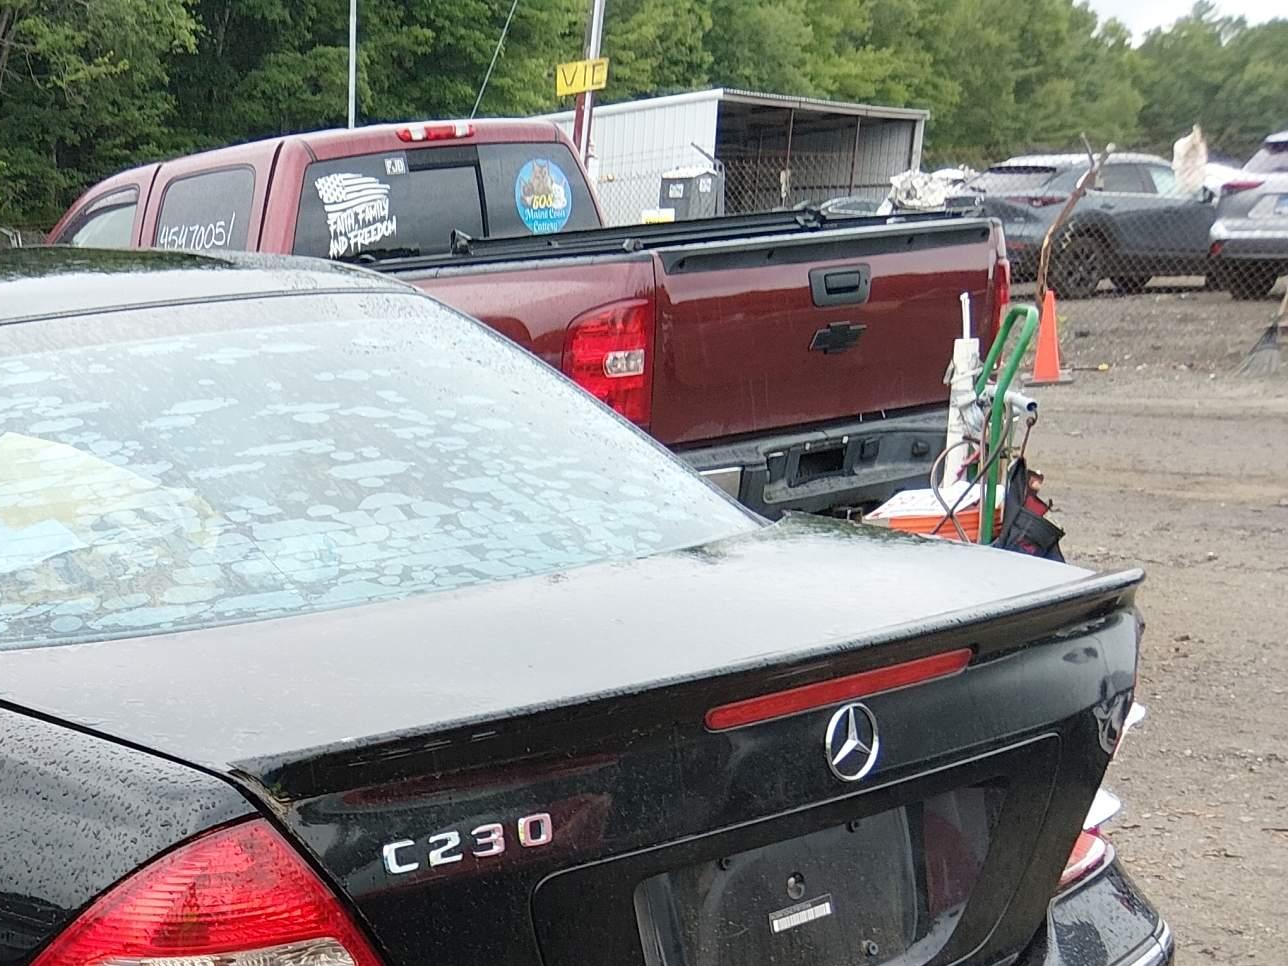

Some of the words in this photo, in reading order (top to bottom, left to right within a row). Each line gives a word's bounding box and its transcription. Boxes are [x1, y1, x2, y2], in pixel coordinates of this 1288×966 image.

[159, 211, 236, 250] 45470051
[357, 195, 389, 227] FAMILY
[329, 235, 348, 259] AND
[349, 215, 397, 253] FREEDOM
[382, 812, 553, 874] C230
